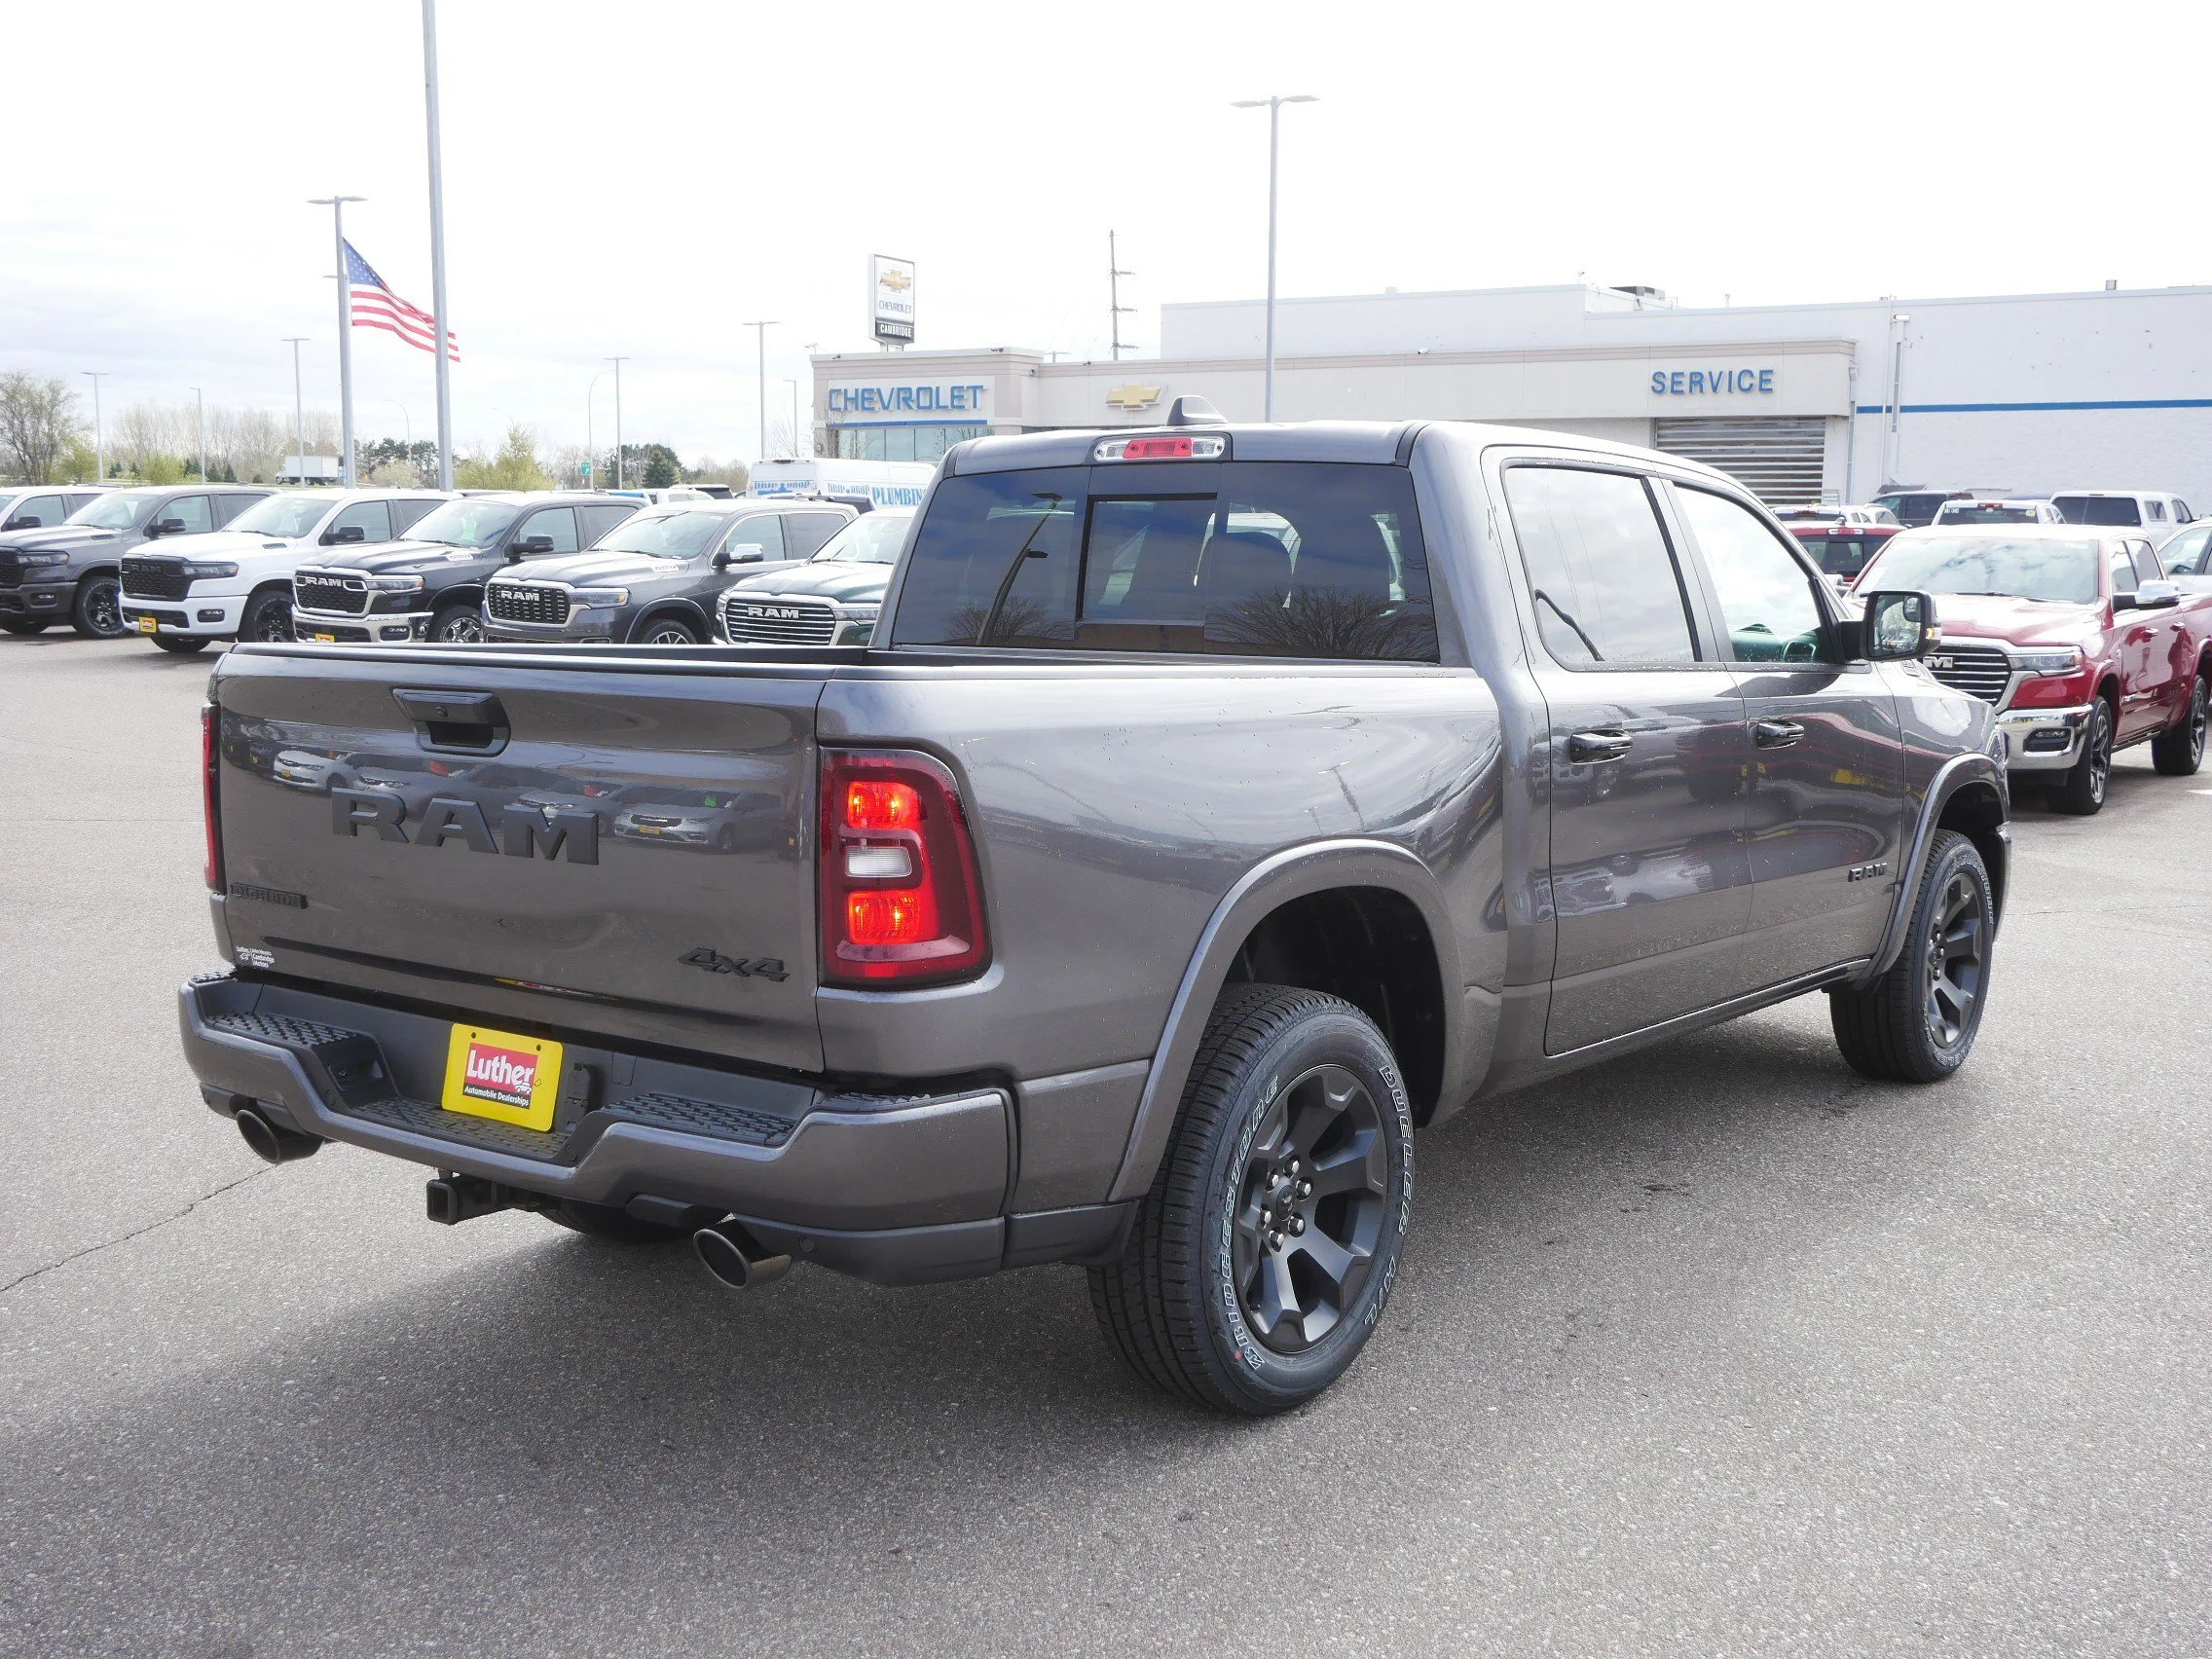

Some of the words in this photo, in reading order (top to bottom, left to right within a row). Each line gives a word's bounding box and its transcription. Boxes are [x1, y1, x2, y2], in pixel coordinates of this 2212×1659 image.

[879, 301, 911, 313] CHEVROLET
[880, 323, 912, 337] CAMBRIDGE
[1650, 369, 1774, 395] SERVICE
[828, 385, 984, 412] CHEVROLET
[871, 486, 928, 505] PLUMBIN
[306, 576, 342, 587] RAM
[500, 589, 540, 602] RAM
[748, 607, 799, 619] RAM
[331, 787, 600, 866] RAM
[1848, 863, 1888, 883] RAM
[466, 1050, 535, 1087] Luther
[464, 1086, 498, 1099] Automobile
[498, 1090, 530, 1107] Dealerships
[1379, 1065, 1414, 1236] DUELER
[1217, 1074, 1278, 1370] BRIDGESTONE
